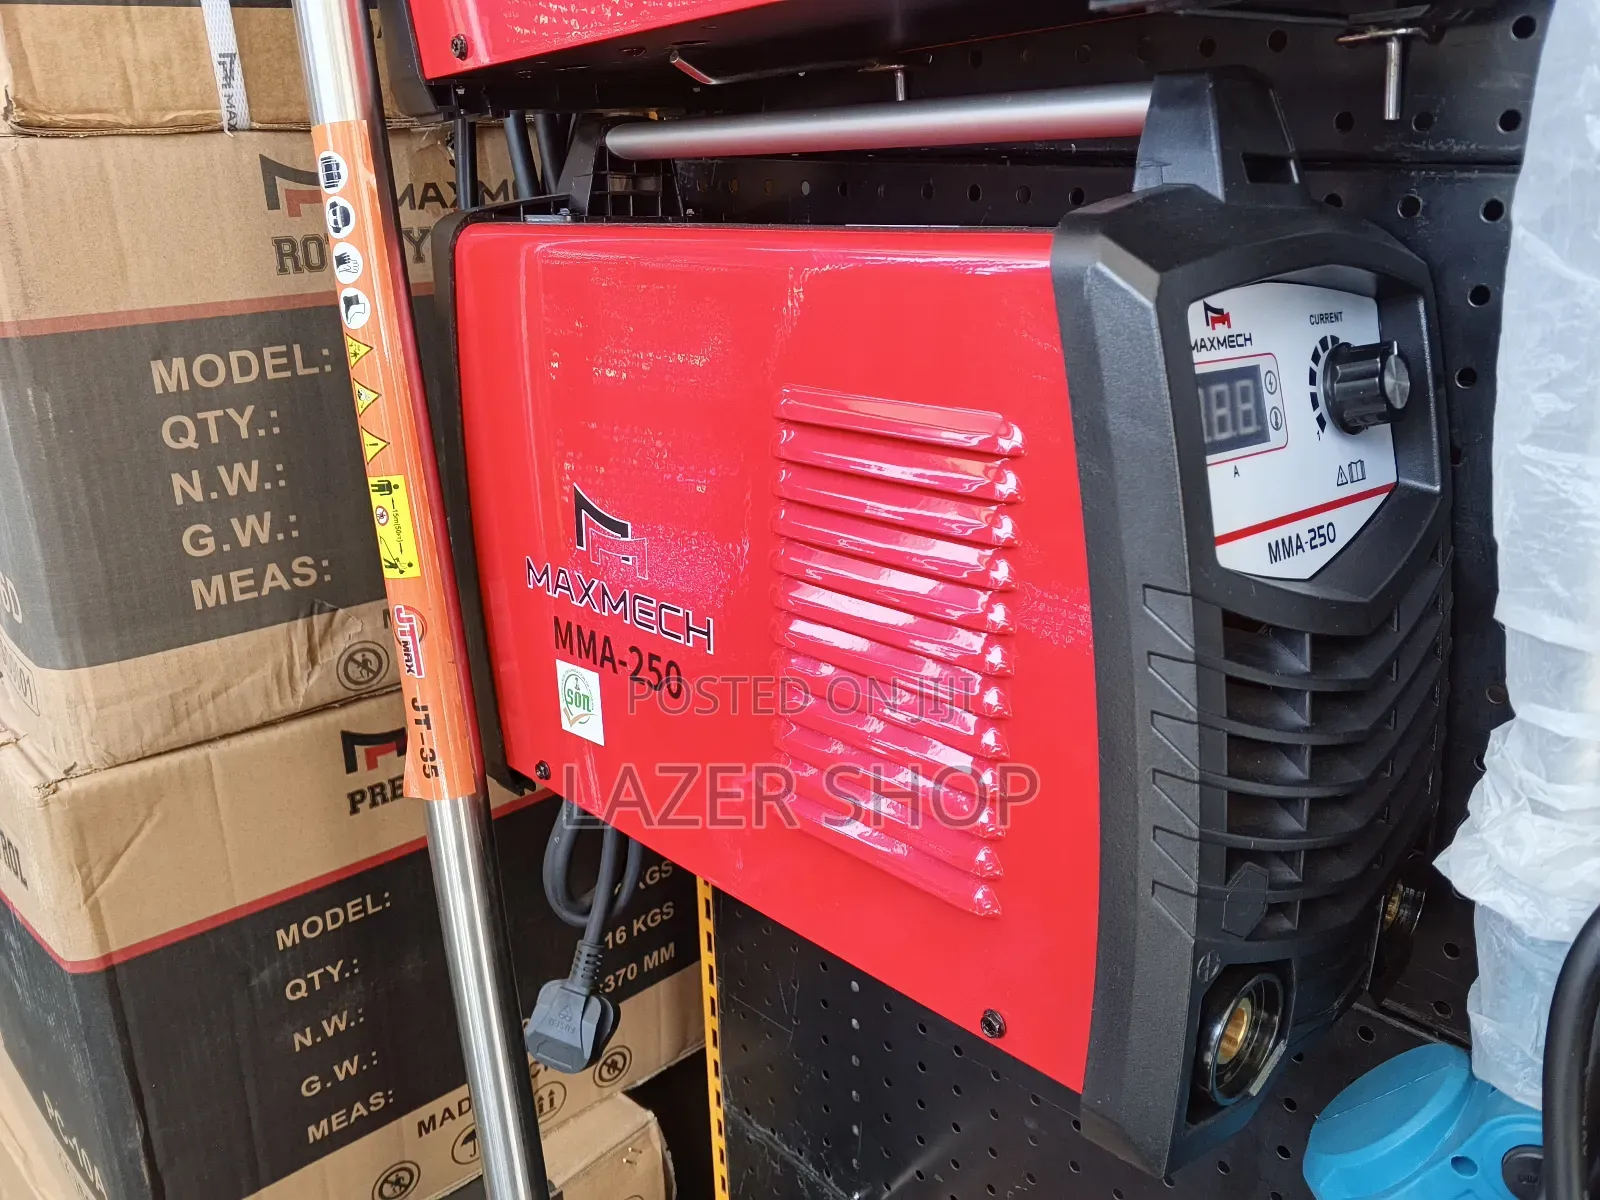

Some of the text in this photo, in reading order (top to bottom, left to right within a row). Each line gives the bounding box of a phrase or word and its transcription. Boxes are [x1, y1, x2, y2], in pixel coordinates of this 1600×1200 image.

[272, 227, 431, 275] ROY
[1309, 312, 1343, 326] CURRENT
[150, 344, 332, 394] MODEL:
[161, 405, 281, 450] QTY.:
[171, 460, 286, 505] N.W.:
[1233, 465, 1241, 479] A
[182, 511, 300, 557] G.W.:
[1267, 522, 1337, 565] MMA-250
[191, 556, 332, 610] MEAS:
[524, 555, 715, 656] MAXMECH
[401, 640, 415, 675] MAX
[553, 615, 682, 700] MMA-250
[411, 697, 440, 779] JT-35
[347, 780, 404, 816] PRE
[639, 859, 673, 889] GS
[276, 892, 391, 951] MODEL:
[605, 901, 674, 950] 16 KGS
[643, 941, 675, 972] MM
[285, 958, 360, 1001] QTY.:
[293, 1008, 364, 1052] N.W.:
[300, 1051, 378, 1098] G.W.:
[307, 1091, 394, 1144] MEAS:
[417, 1096, 472, 1139] MAD
